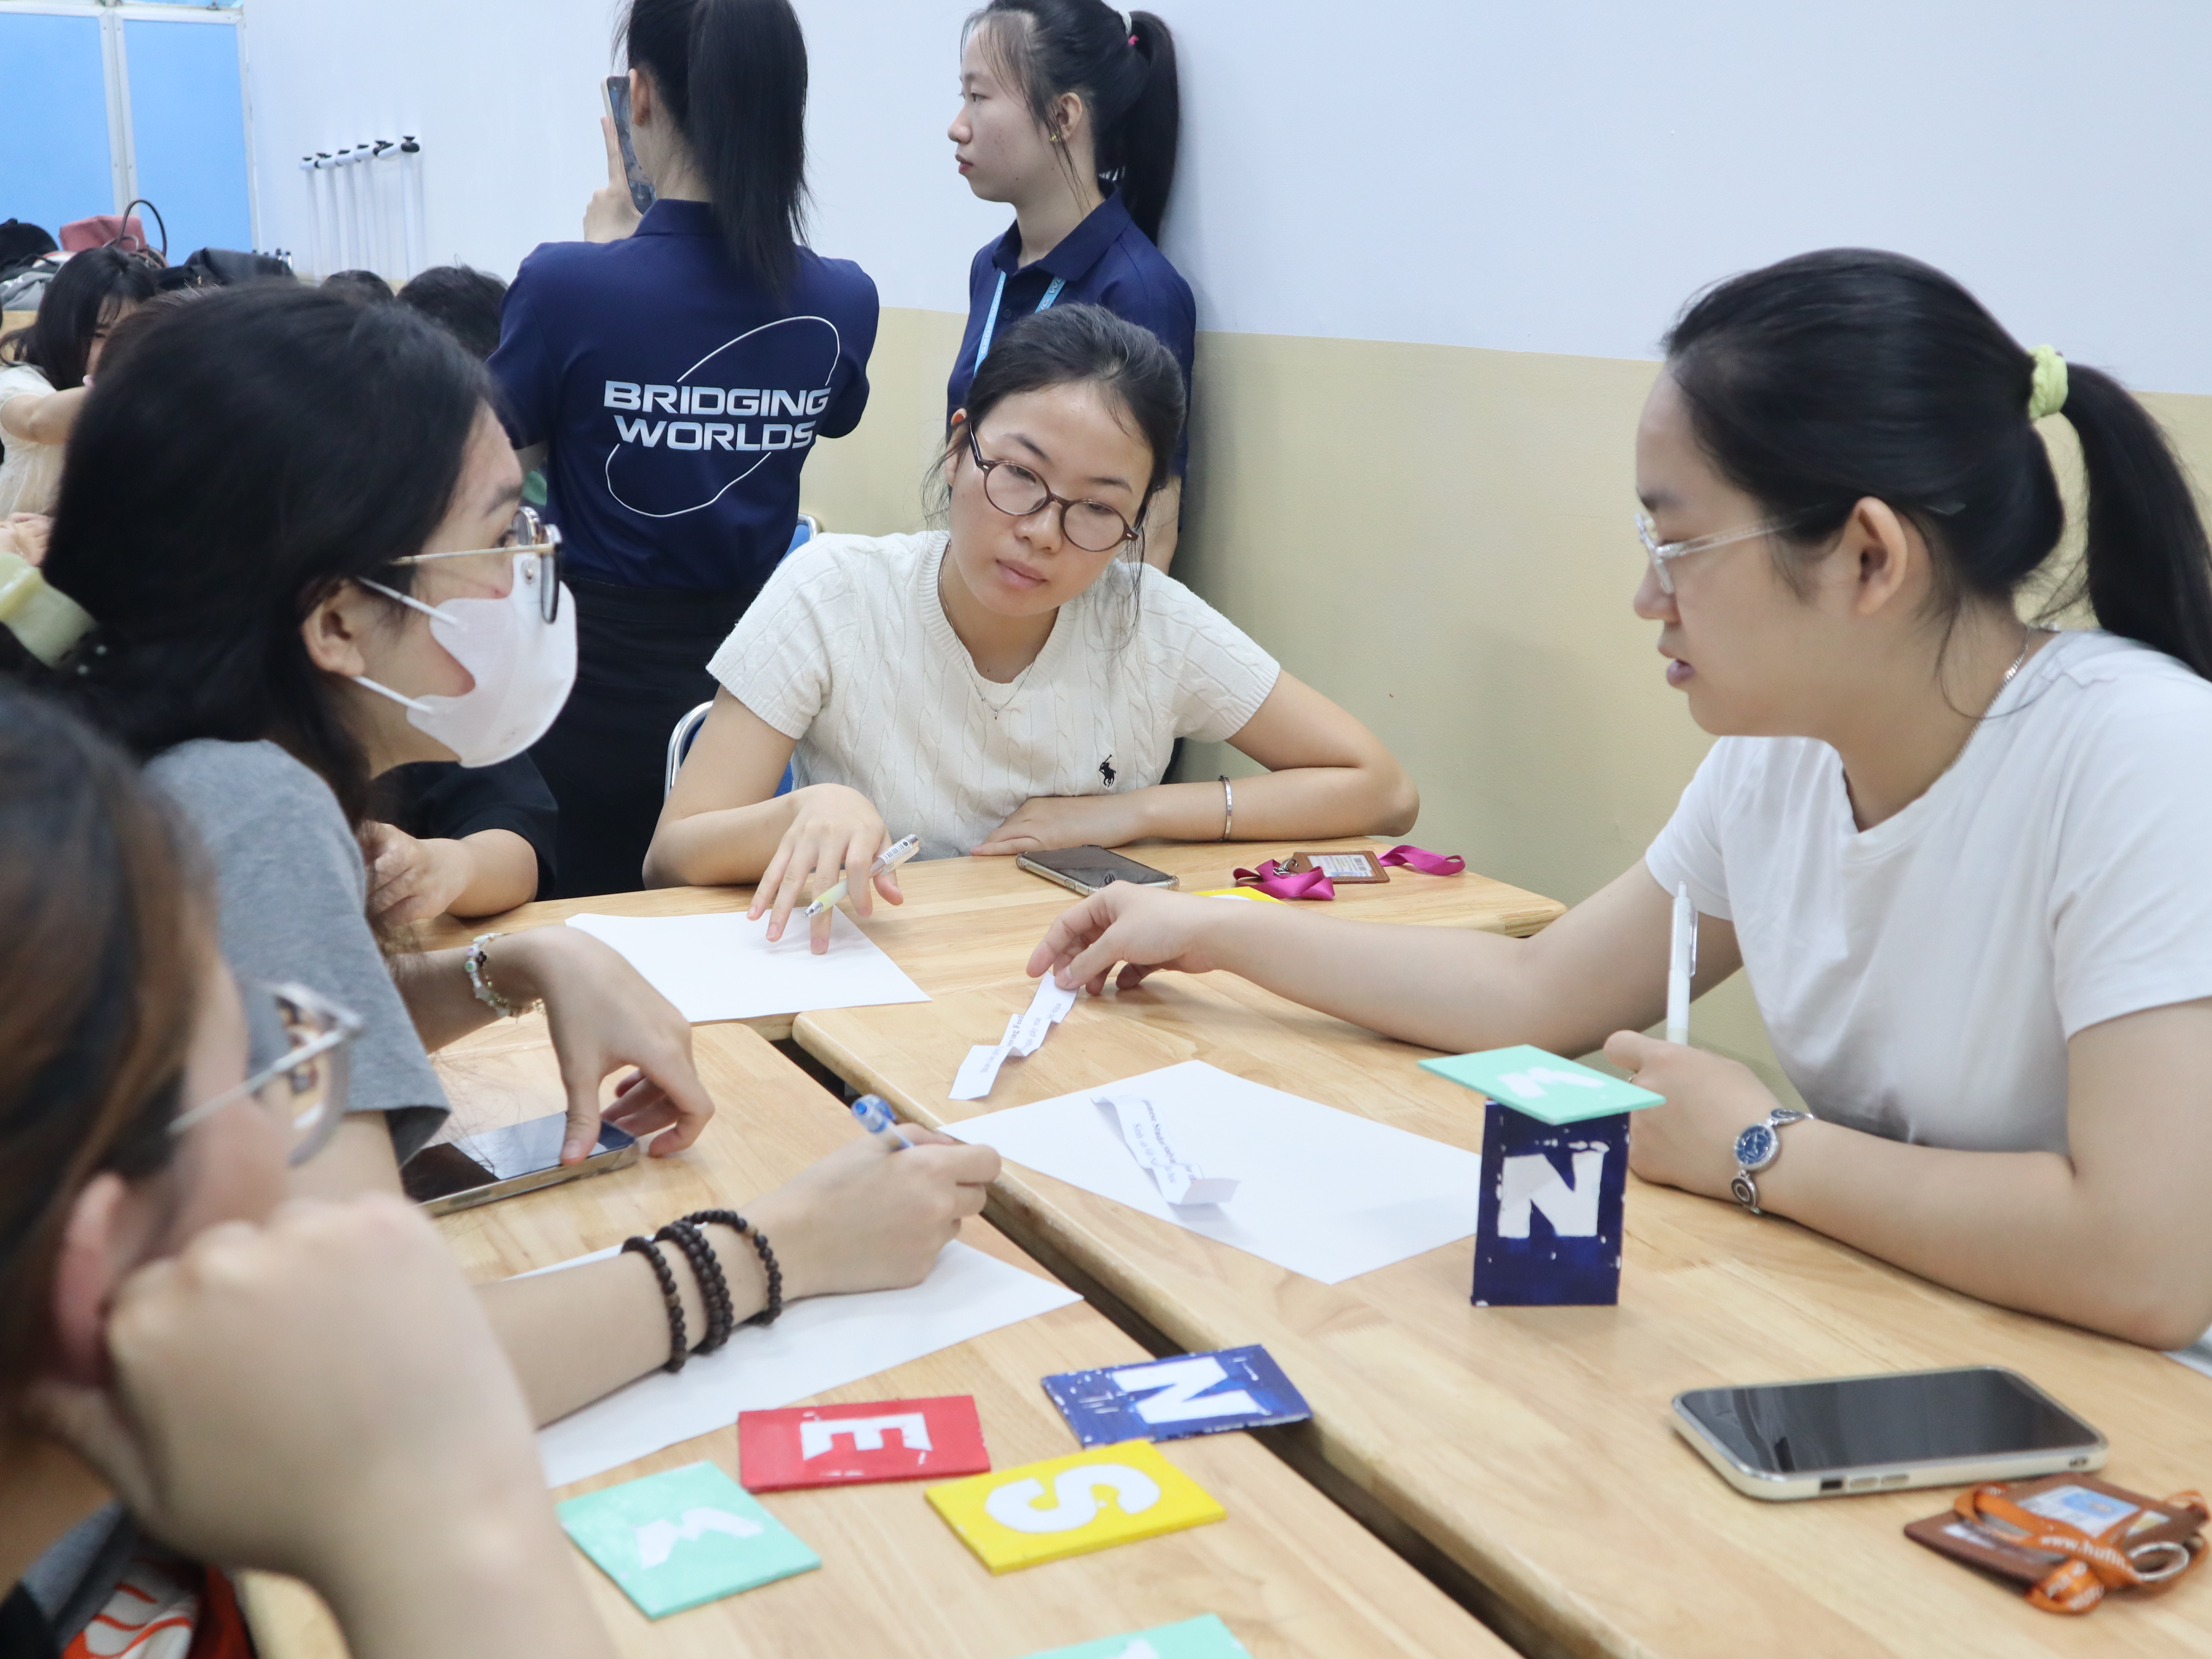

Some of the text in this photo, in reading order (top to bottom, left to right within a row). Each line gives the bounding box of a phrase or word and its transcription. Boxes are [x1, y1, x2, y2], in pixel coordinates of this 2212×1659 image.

[603, 380, 831, 416] BRIDGING
[613, 415, 816, 451] WORLDS
[1497, 1150, 1608, 1239] N
[1112, 1356, 1265, 1424] N
[799, 1412, 933, 1461] E
[984, 1462, 1161, 1534] S
